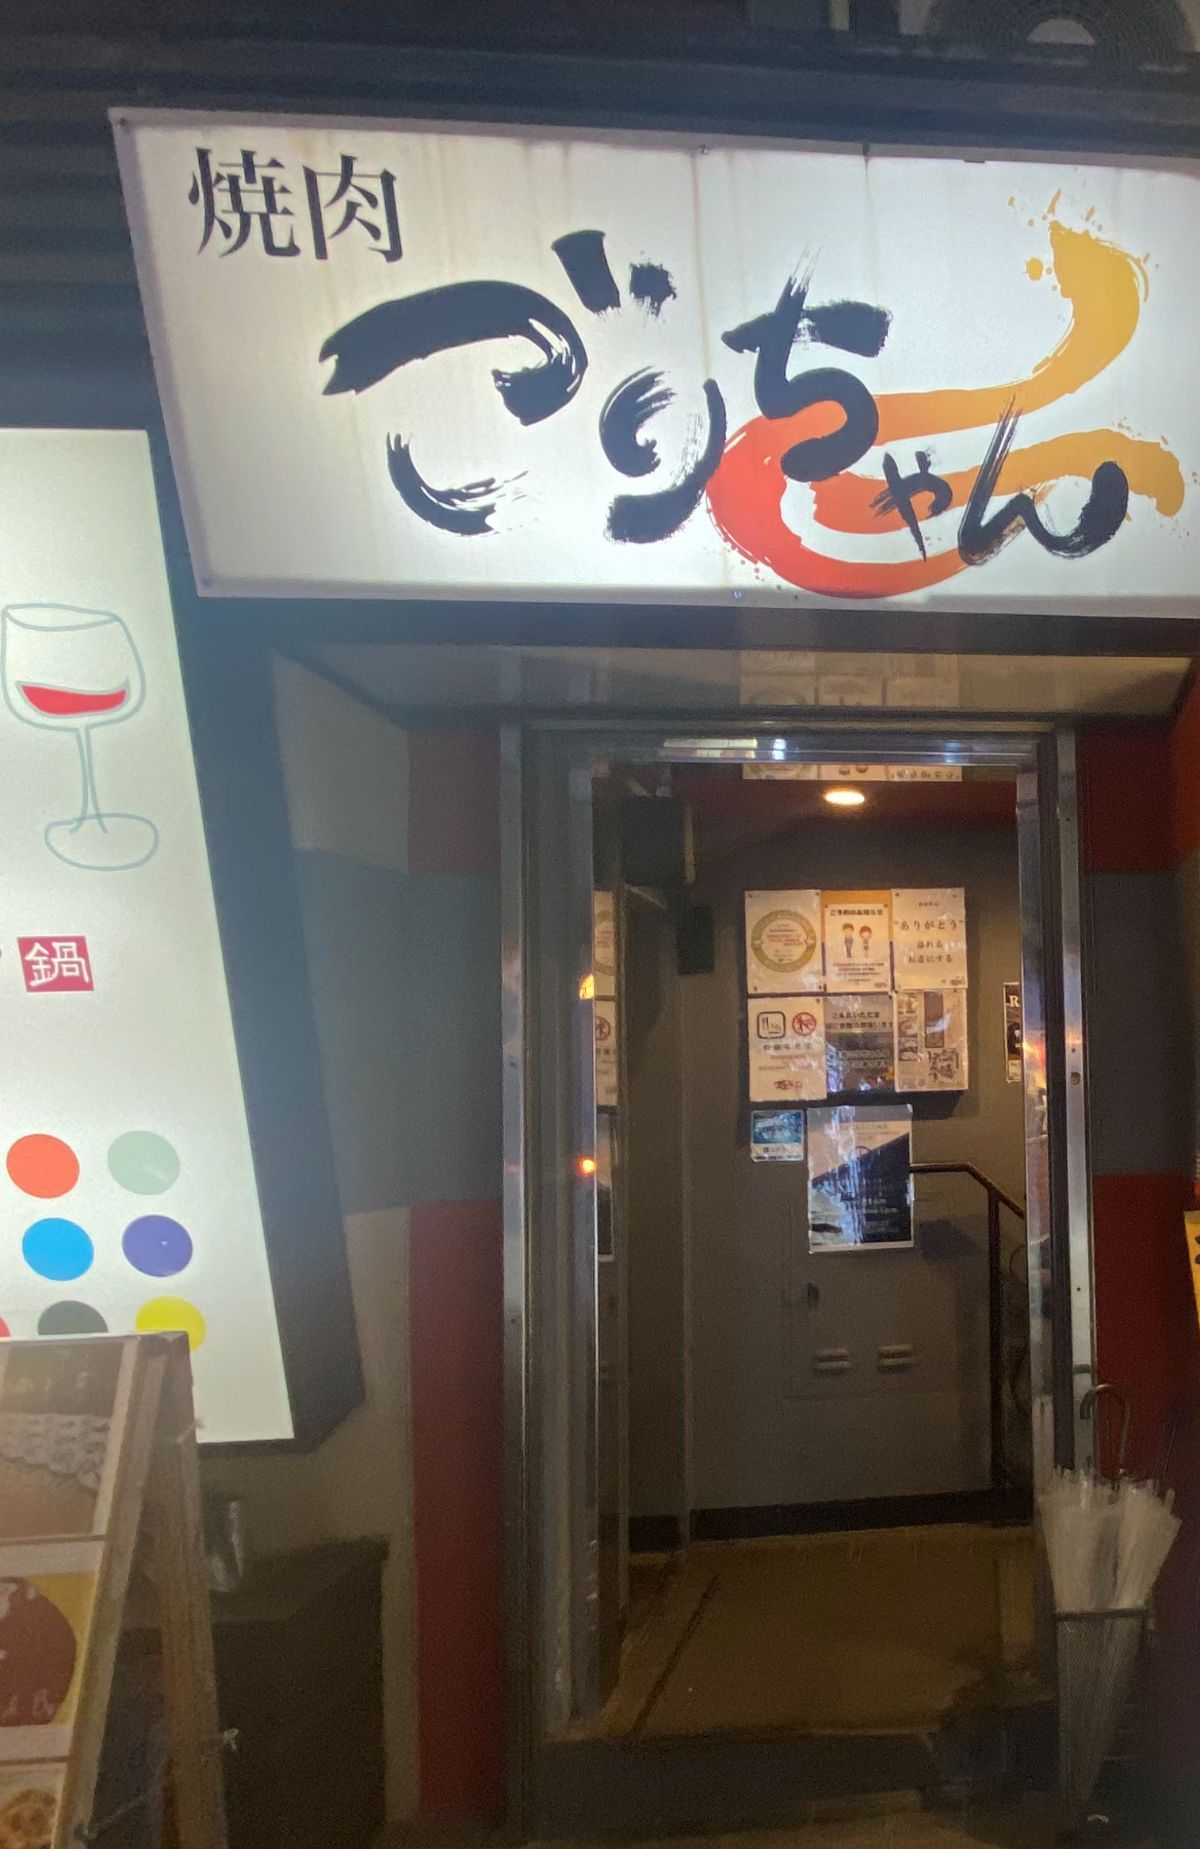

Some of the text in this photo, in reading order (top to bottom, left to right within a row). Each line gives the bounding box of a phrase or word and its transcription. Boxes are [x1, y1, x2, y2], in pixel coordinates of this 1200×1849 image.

[188, 146, 404, 263] 焼肉
[319, 230, 1129, 564] ごりちゃん
[24, 942, 89, 987] 鍋
